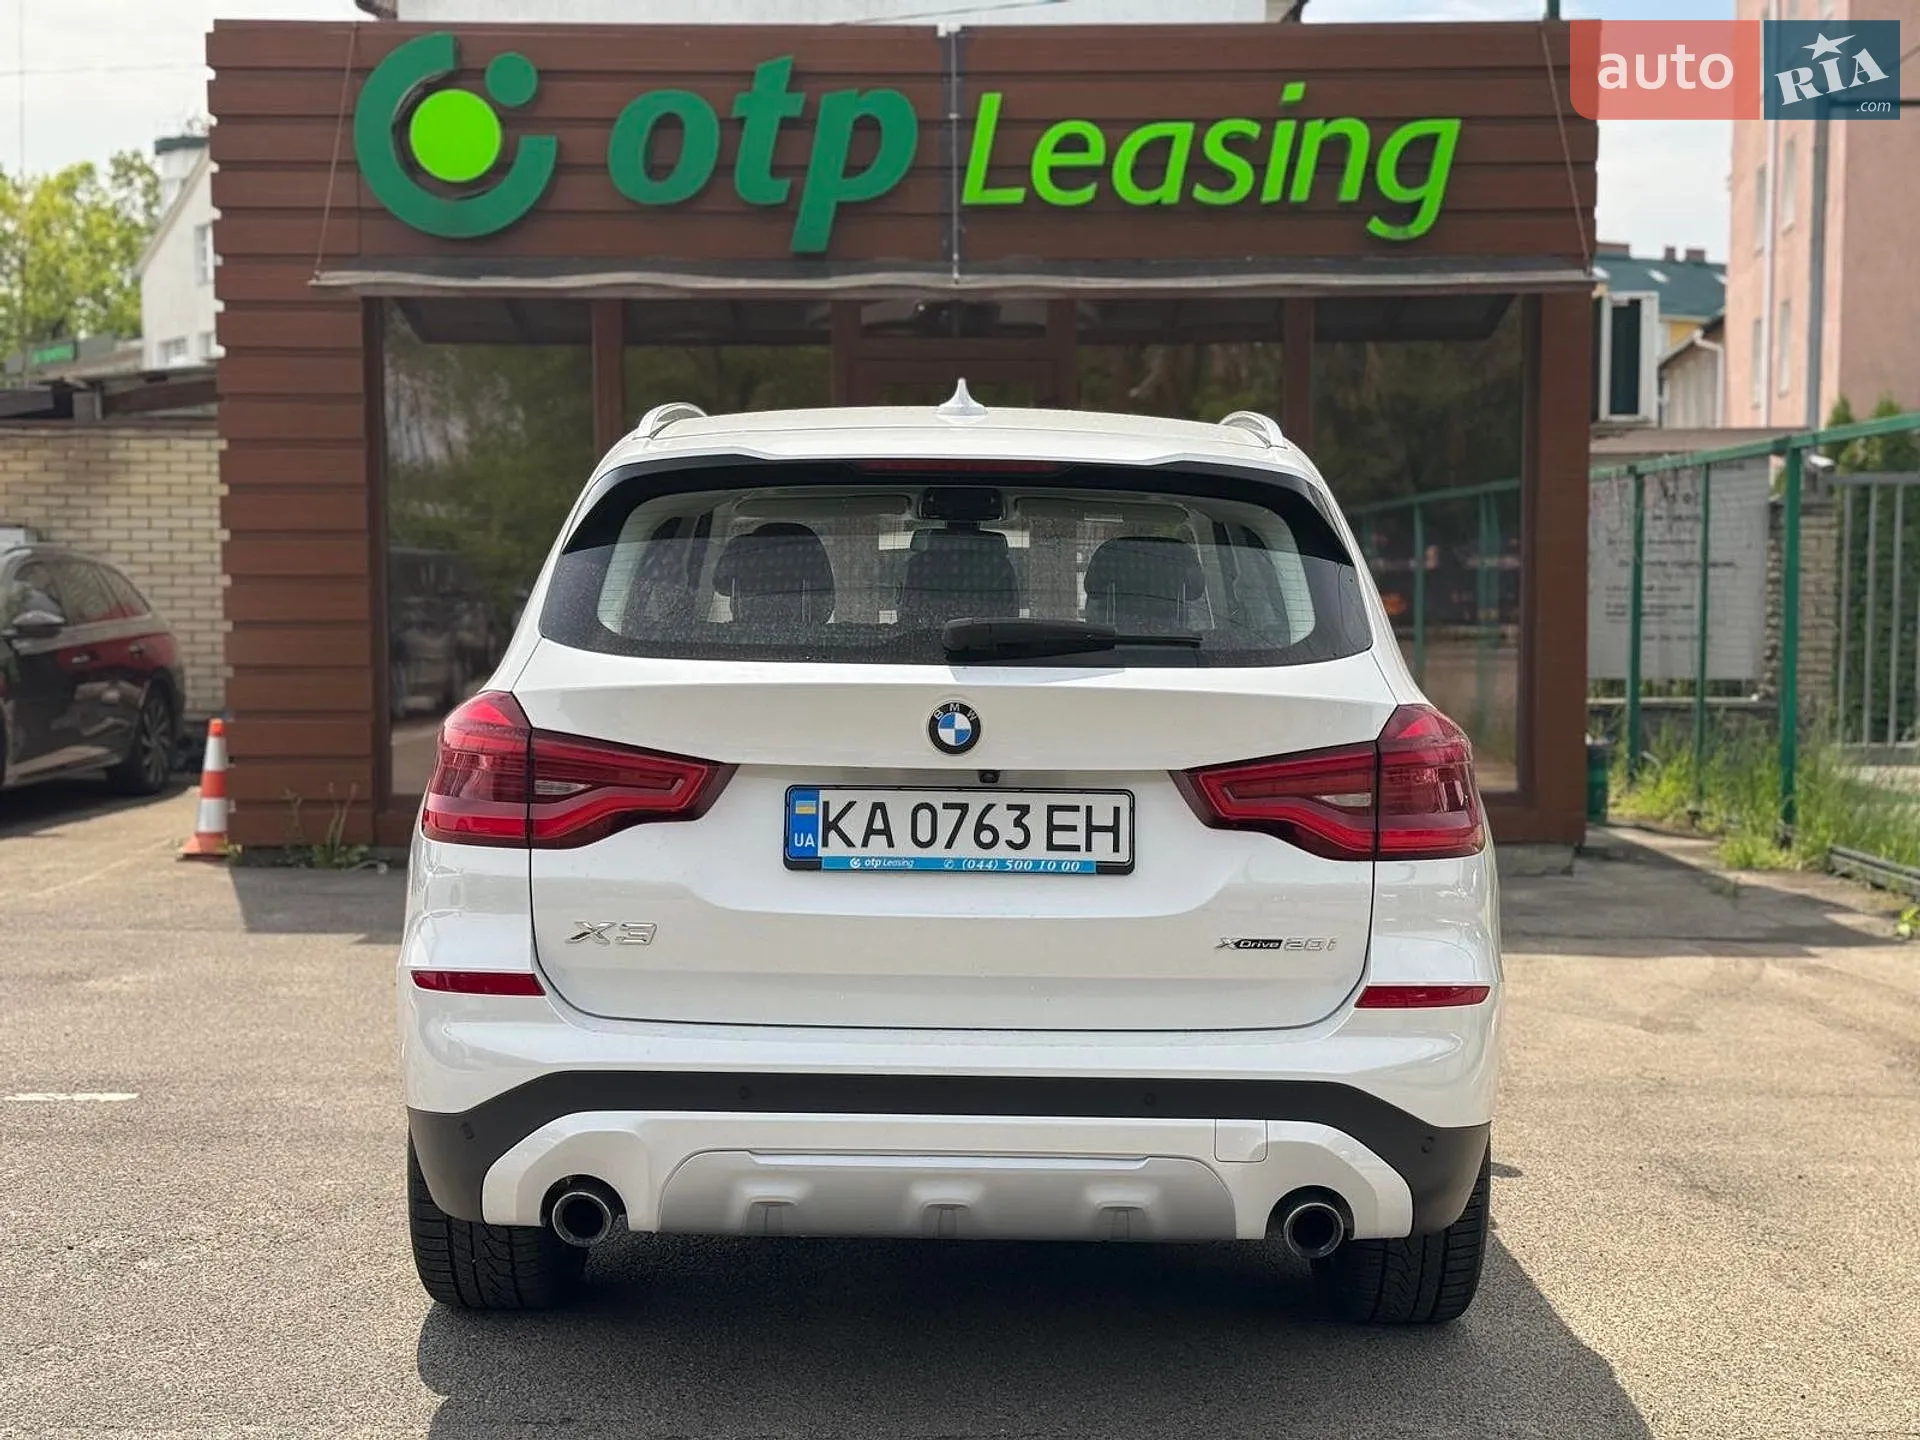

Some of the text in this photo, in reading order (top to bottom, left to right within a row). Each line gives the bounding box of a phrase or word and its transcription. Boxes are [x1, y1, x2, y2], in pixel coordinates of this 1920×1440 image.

[608, 55, 1462, 253] otp Leasing
[933, 702, 978, 721] BMW
[820, 800, 1120, 852] KA 0763 EH
[794, 835, 815, 848] UA
[864, 858, 914, 869] otp Leasing
[962, 859, 1080, 872] (044) 500 10 00
[565, 920, 658, 946] X3
